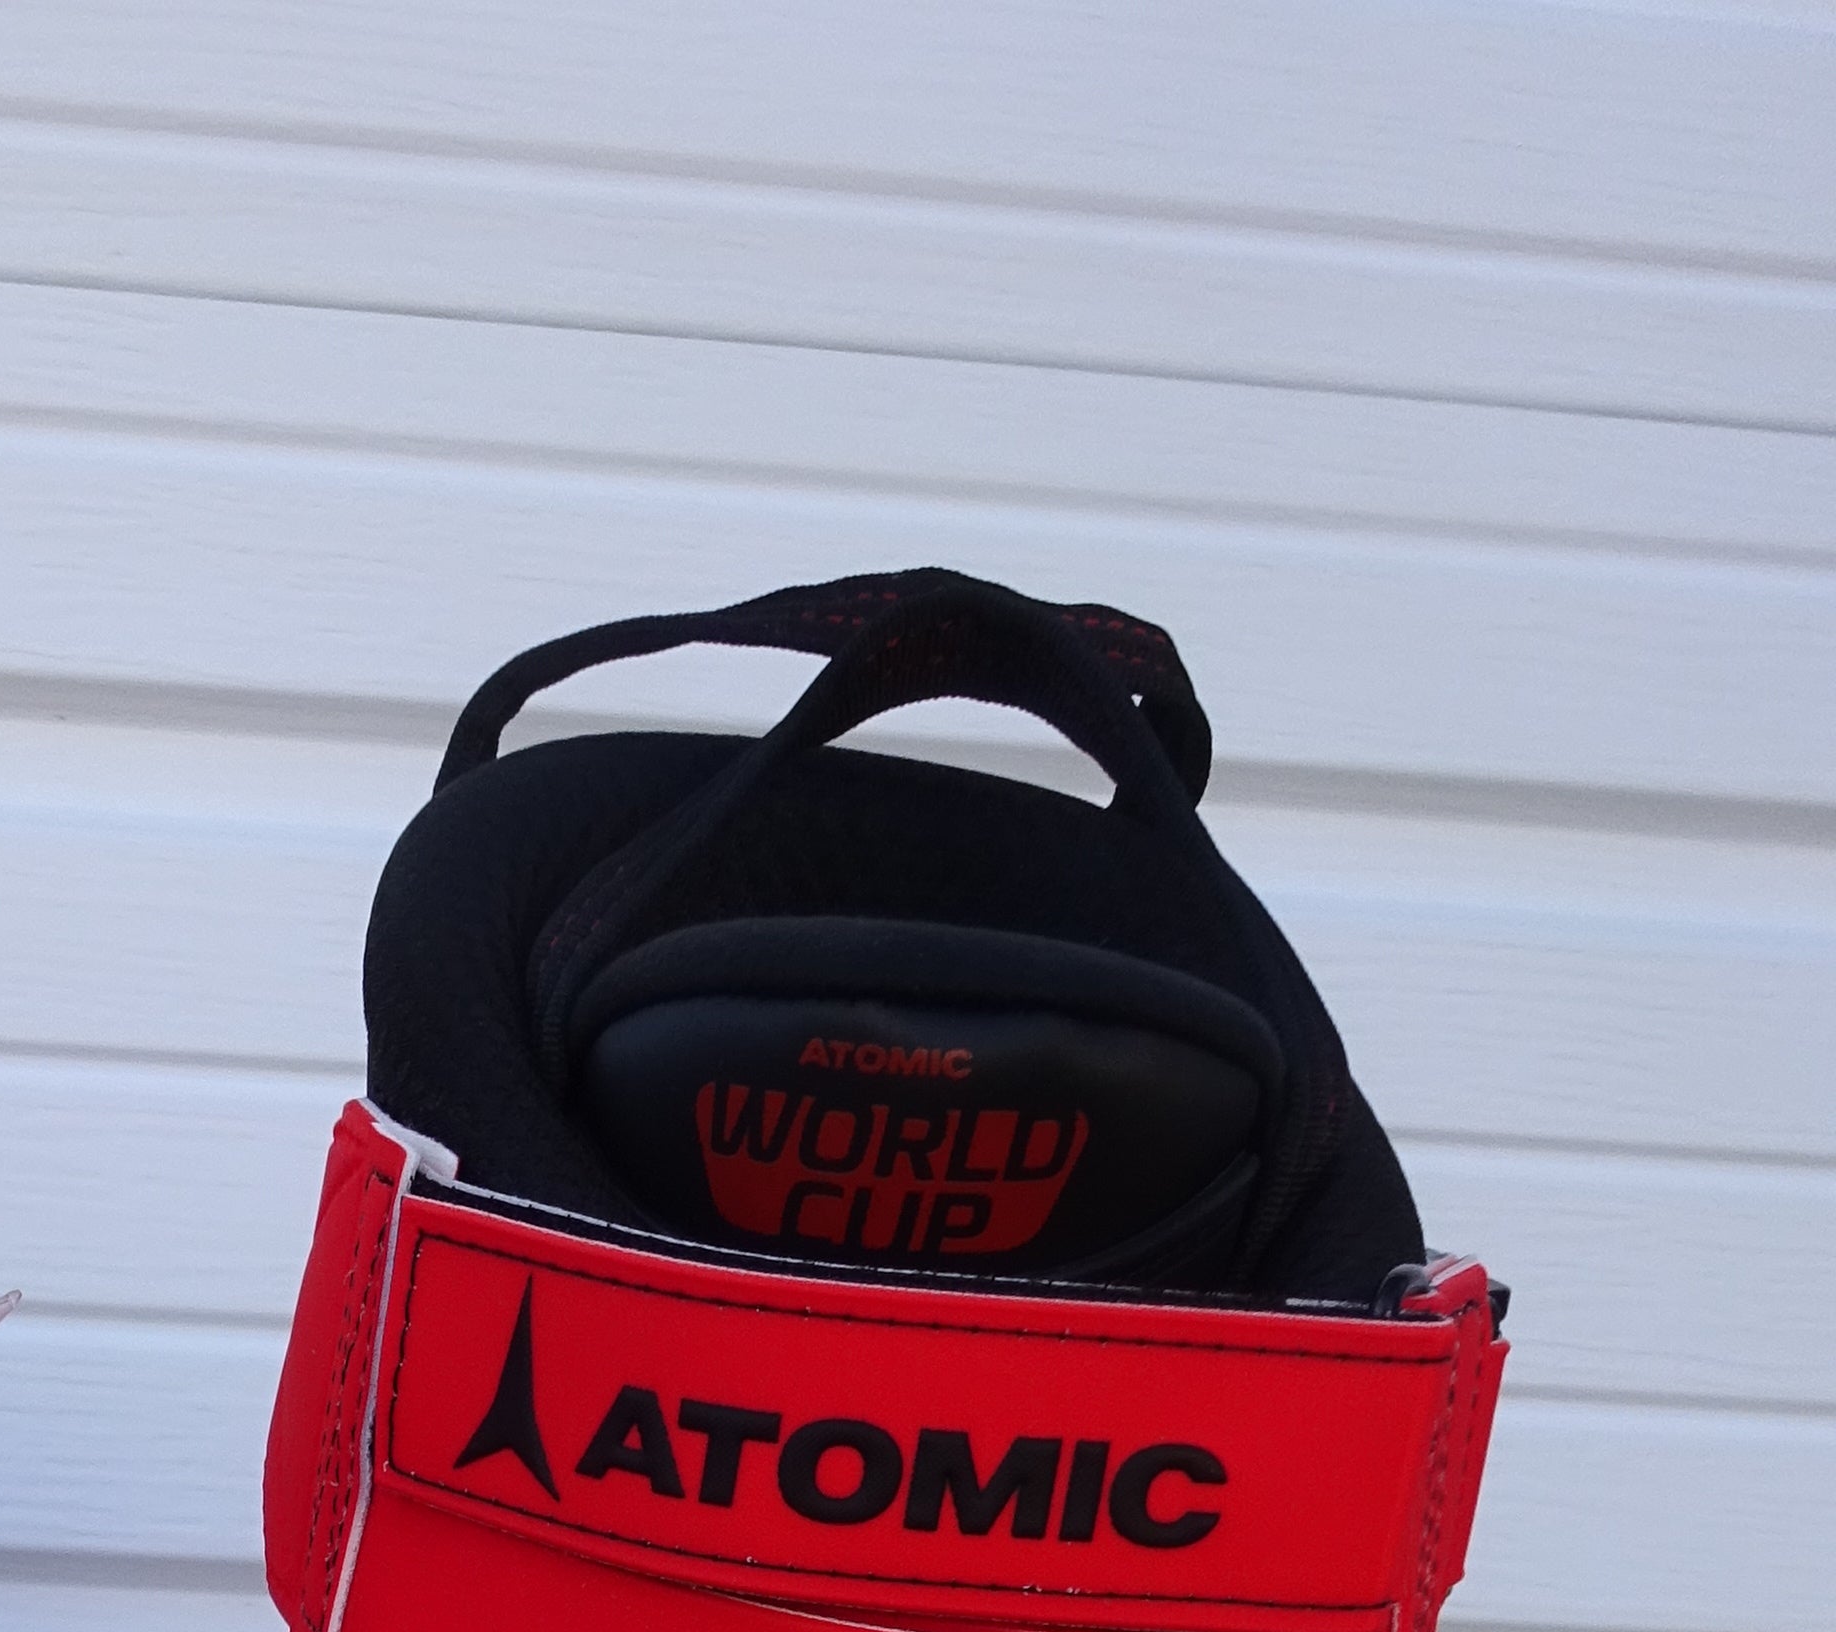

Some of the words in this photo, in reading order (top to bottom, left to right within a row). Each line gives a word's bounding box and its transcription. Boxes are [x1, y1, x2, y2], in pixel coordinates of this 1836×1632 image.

[799, 1037, 974, 1079] ATOMIC
[702, 1081, 1080, 1184] WORLD
[779, 1180, 994, 1254] CUP
[575, 1384, 1228, 1549] ATOMIC
